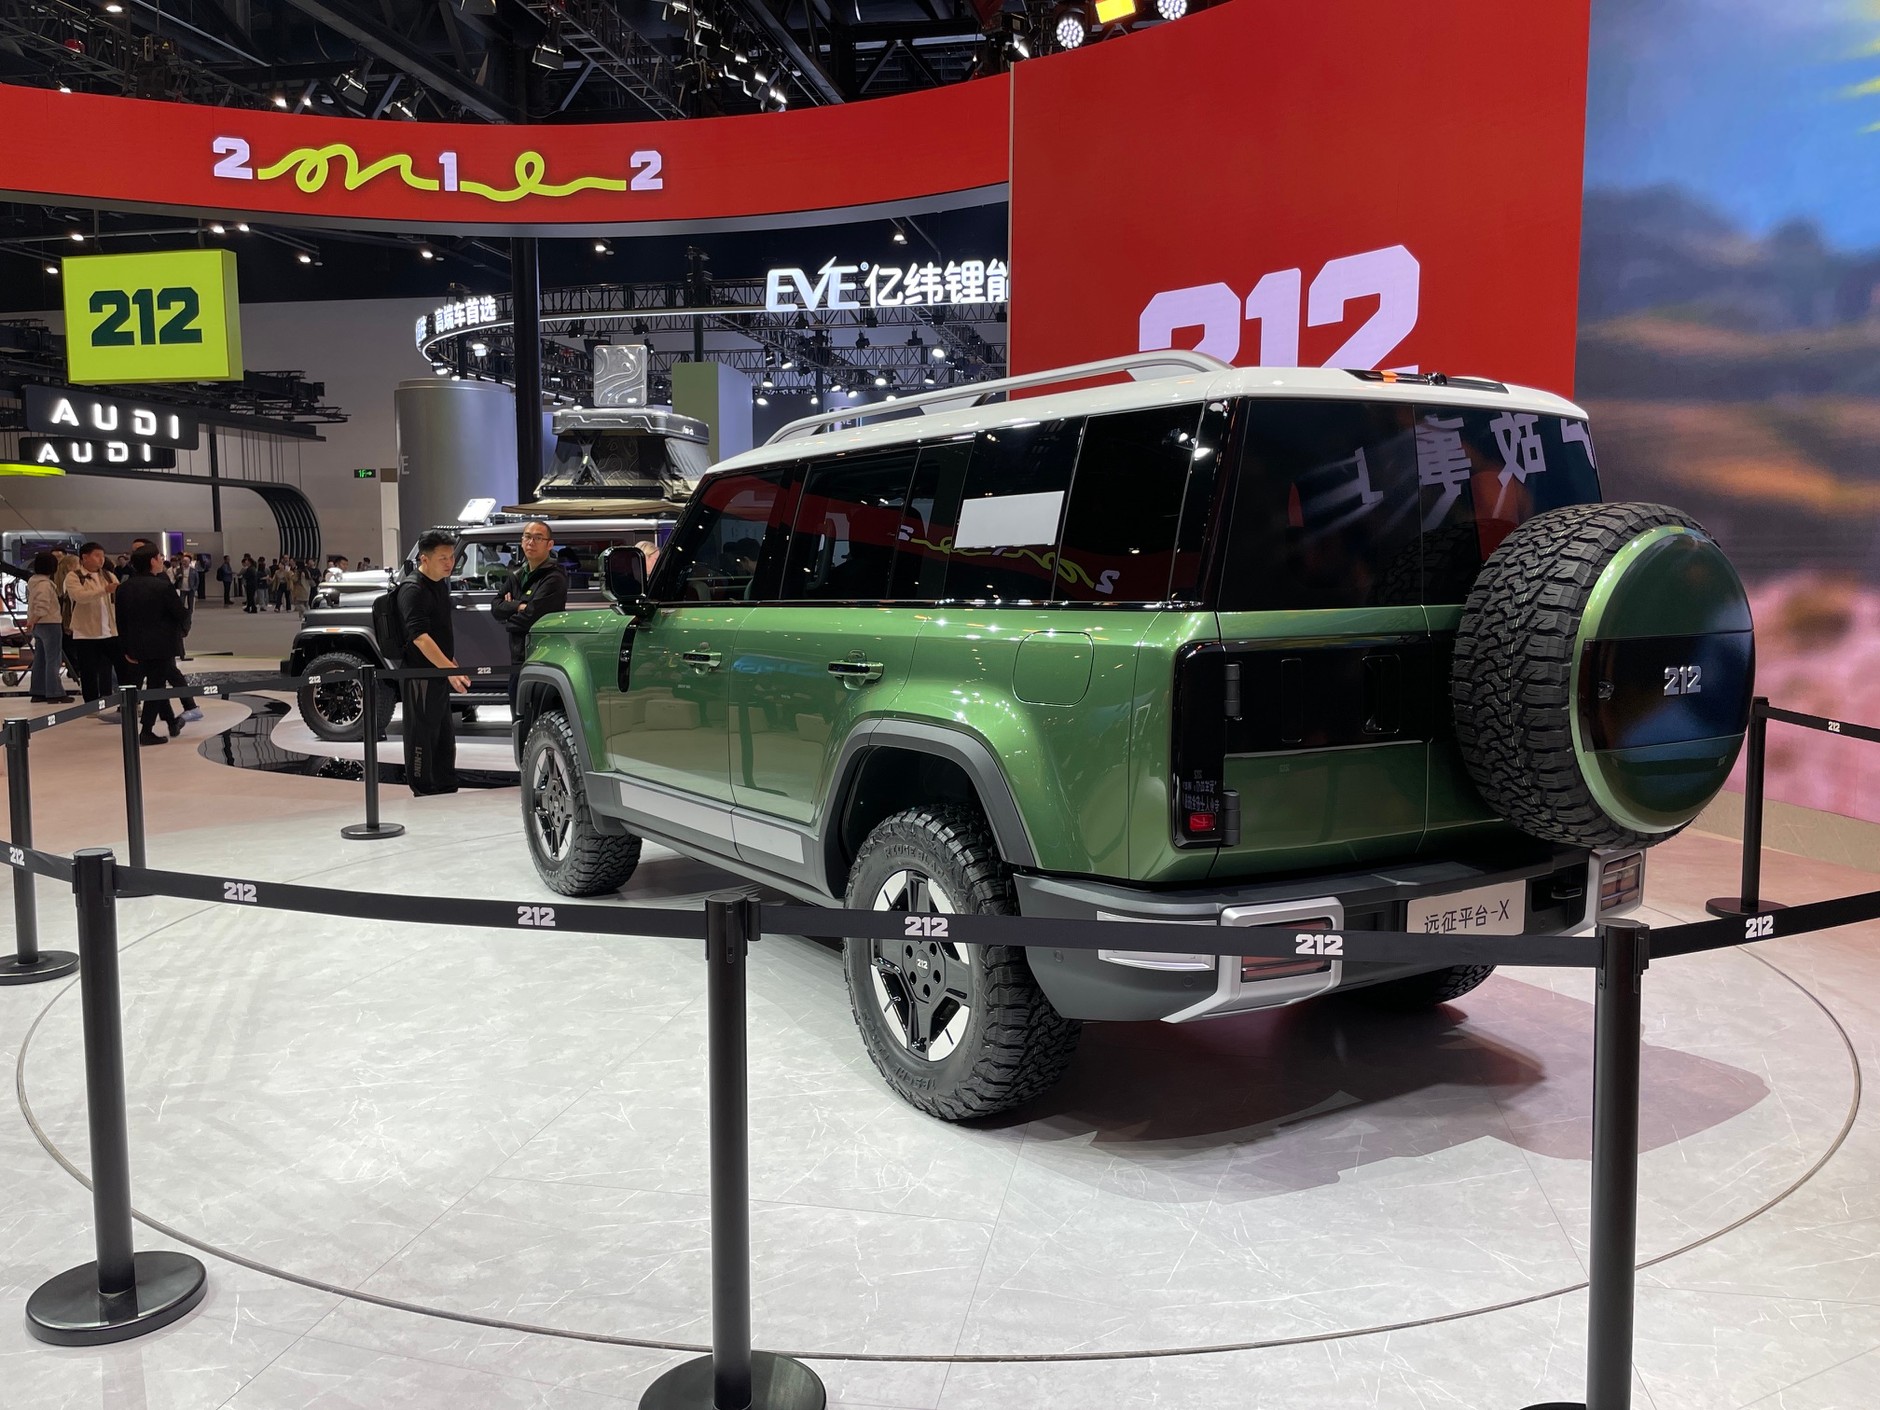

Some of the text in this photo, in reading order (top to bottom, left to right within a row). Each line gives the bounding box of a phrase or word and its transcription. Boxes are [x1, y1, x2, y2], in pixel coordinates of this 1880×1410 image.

[213, 137, 663, 191] 2 1 2
[89, 286, 203, 347] 212
[1139, 245, 1420, 374] 212
[51, 398, 180, 440] AUDI
[37, 441, 151, 463] AUDI
[308, 675, 321, 684] 212
[478, 667, 492, 675] 212
[1663, 665, 1702, 696] 212
[203, 685, 219, 694] 212
[1828, 721, 1840, 732] 212
[9, 847, 25, 866] 212
[223, 881, 258, 902] 212
[517, 905, 556, 927] 212
[904, 916, 949, 937] 212
[1424, 899, 1510, 934] 远征平台-X
[1745, 914, 1774, 939] 212
[1295, 933, 1343, 956] 212
[916, 958, 928, 970] 212
